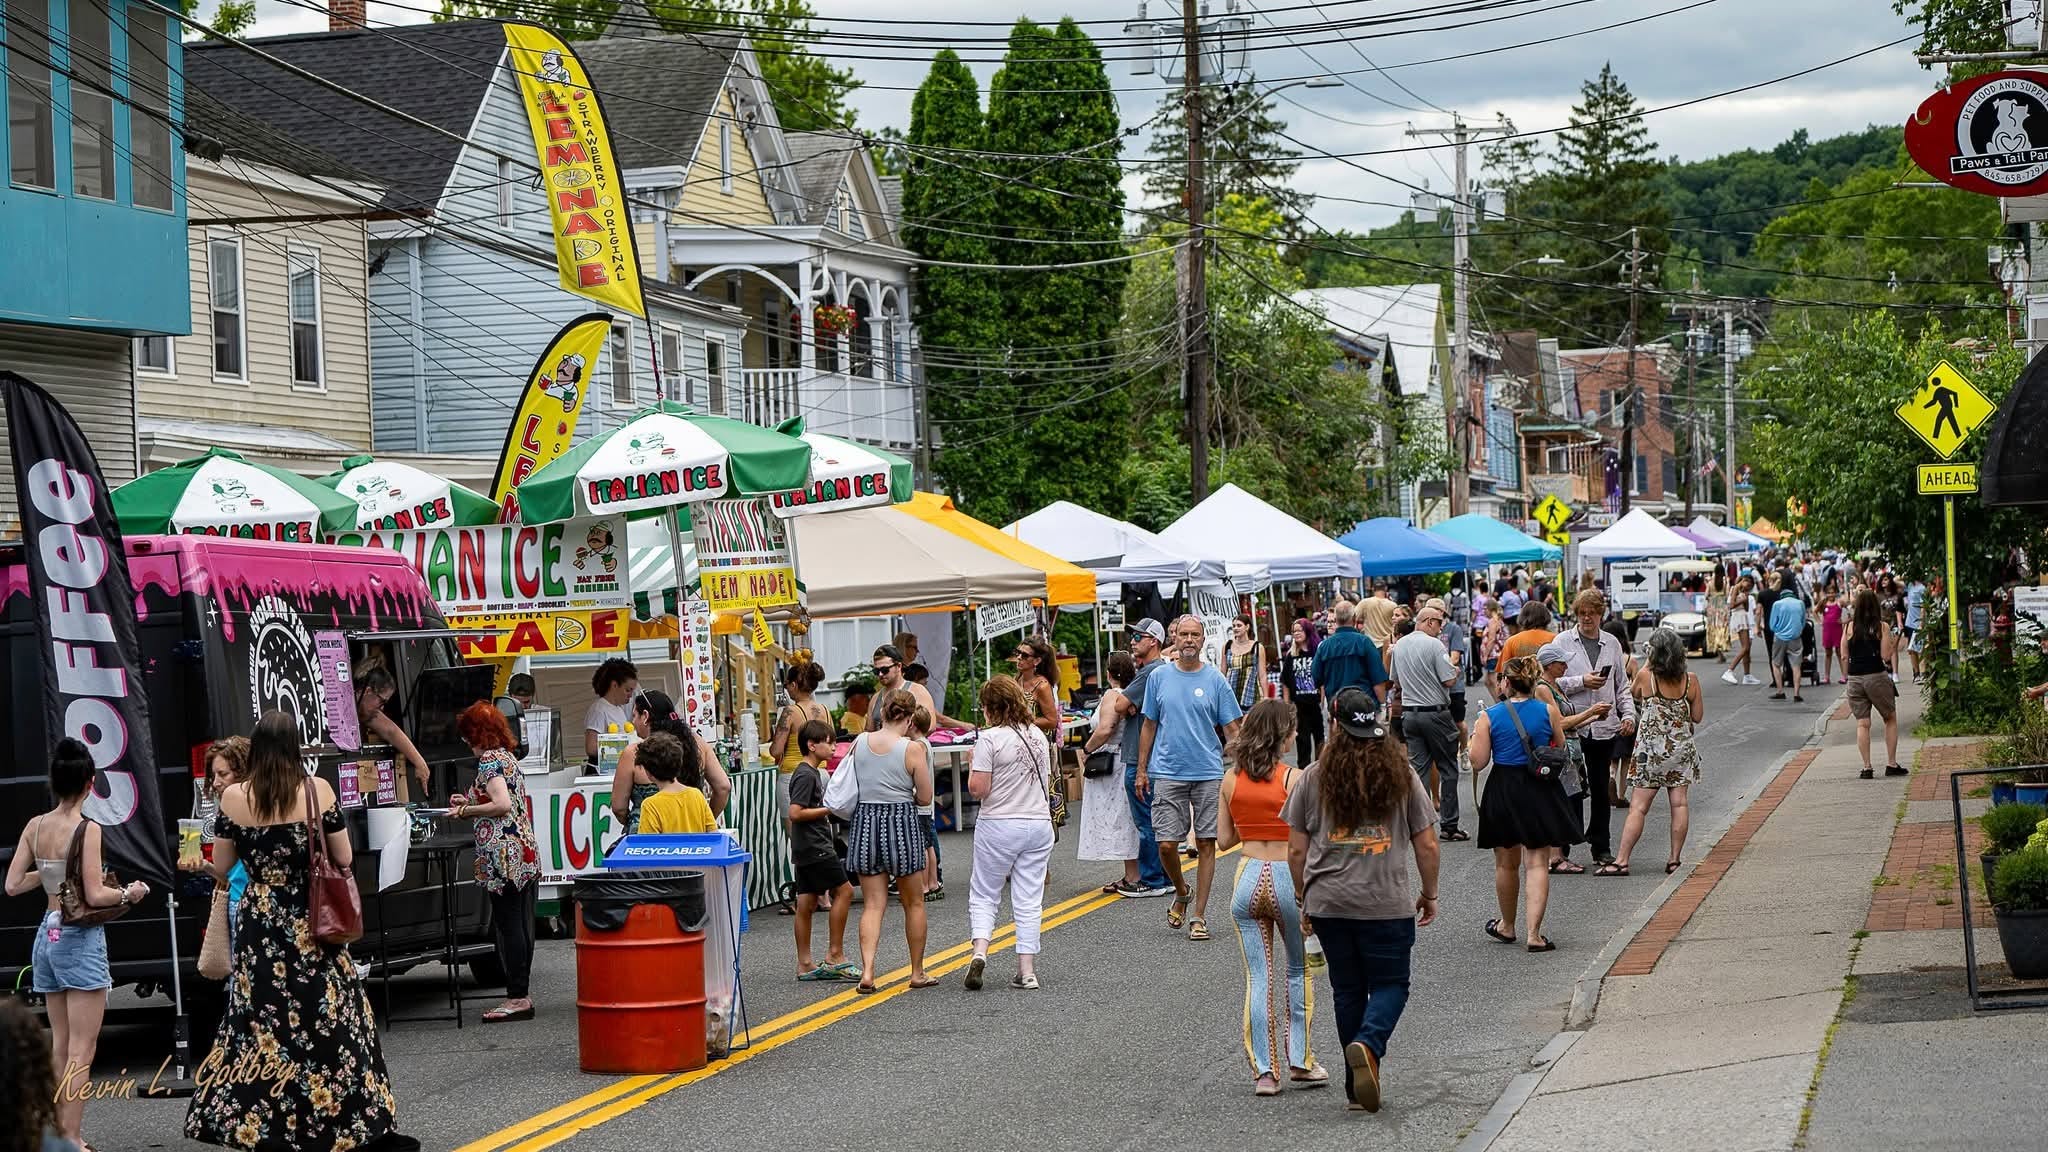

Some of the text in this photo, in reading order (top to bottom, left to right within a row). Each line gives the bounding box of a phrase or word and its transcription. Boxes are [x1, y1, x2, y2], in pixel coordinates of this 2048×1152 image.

[1962, 103, 1977, 121] PET
[1974, 85, 1996, 104] FOOD
[1999, 80, 2018, 90] AND
[577, 101, 607, 191] STRAWBERRY
[1960, 158, 1991, 169] Paws
[2003, 154, 2026, 164] Tail
[603, 208, 626, 282] ORIGINAL
[588, 464, 722, 505] ITALIAN ICE
[854, 473, 888, 497] ICE
[1925, 471, 1971, 486] AHEAD
[415, 497, 451, 526] ICE
[275, 521, 313, 544] ICE
[502, 522, 567, 599] ICE
[249, 595, 275, 639] HOLE
[272, 596, 288, 622] IN
[289, 605, 312, 654] THE
[484, 612, 551, 621] ORIGINAL
[551, 792, 612, 870] ICE
[625, 846, 712, 857] RECYCLABLES
